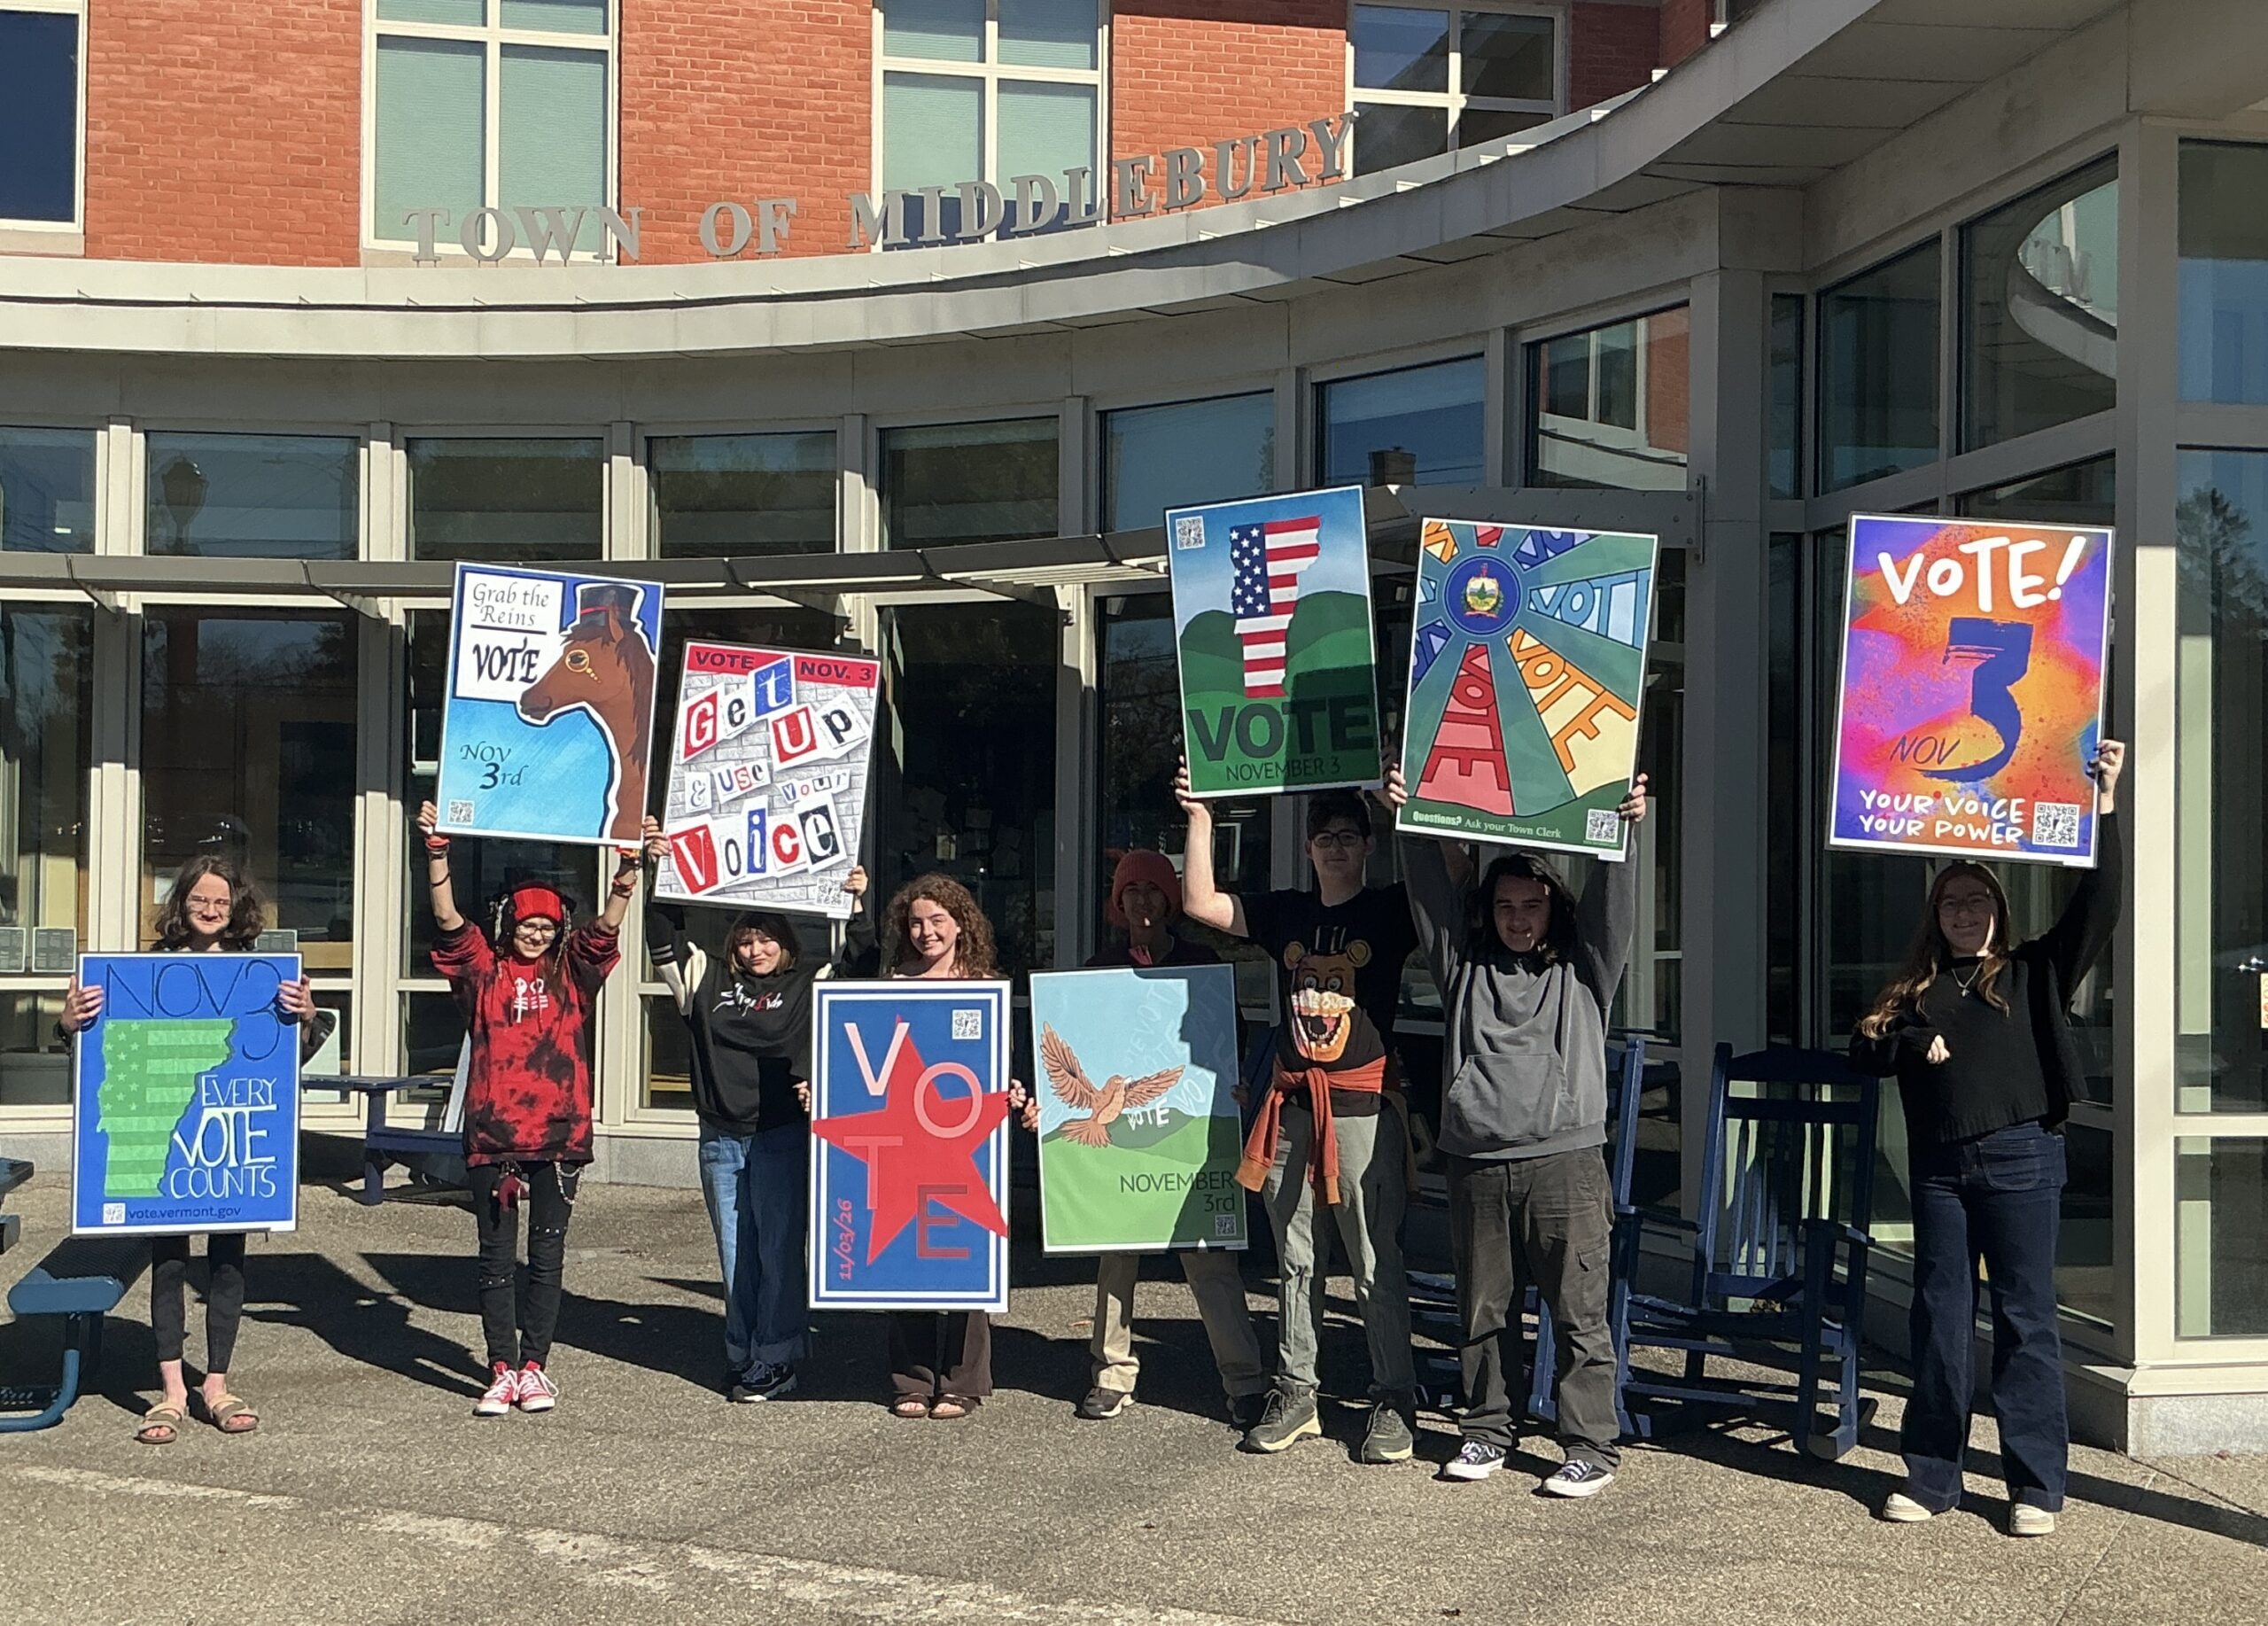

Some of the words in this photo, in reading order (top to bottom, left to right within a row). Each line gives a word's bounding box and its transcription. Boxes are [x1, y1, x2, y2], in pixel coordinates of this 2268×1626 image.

[402, 206, 642, 262] TOWN
[699, 198, 796, 257] OF
[845, 111, 1359, 247] MIDDLEBURY
[473, 582, 517, 608] Grab
[523, 583, 549, 608] the
[480, 605, 536, 626] Reins
[472, 636, 540, 684] VOTE
[695, 650, 755, 671] VOTE
[800, 661, 851, 681] NOV.
[858, 667, 873, 681] 3
[1507, 627, 1637, 775] VOTE
[1912, 617, 2034, 783] 3
[1188, 694, 1372, 762] VOTE
[1420, 643, 1511, 791] VOTE
[1890, 735, 1961, 765] NOV
[479, 761, 529, 790] 3rd
[1226, 758, 1325, 782] NOVEMBER
[1331, 756, 1341, 775] 3
[691, 778, 707, 807] &
[1860, 790, 1933, 814] YOUR
[1946, 796, 2026, 825] VOICE
[1413, 811, 1462, 827] Questions?
[1464, 819, 1481, 829] Ask
[1483, 822, 1505, 834] your
[1508, 823, 1534, 836] Town
[1536, 827, 1561, 838] Clerk
[1859, 813, 1924, 837] YOUR
[1935, 819, 2024, 845] POWER
[105, 961, 244, 1017] NOV
[241, 959, 283, 1062] 3
[201, 1075, 277, 1107] EVERY
[1127, 1097, 1170, 1131] VOTE
[173, 1104, 277, 1168] VOTE
[170, 1165, 277, 1199] COUNTS
[1120, 1171, 1234, 1194] NOVEMBER
[128, 1204, 242, 1221] vote.vermont.gov
[1204, 1193, 1236, 1213] 3rd
[833, 1198, 856, 1281] 11/03/26
